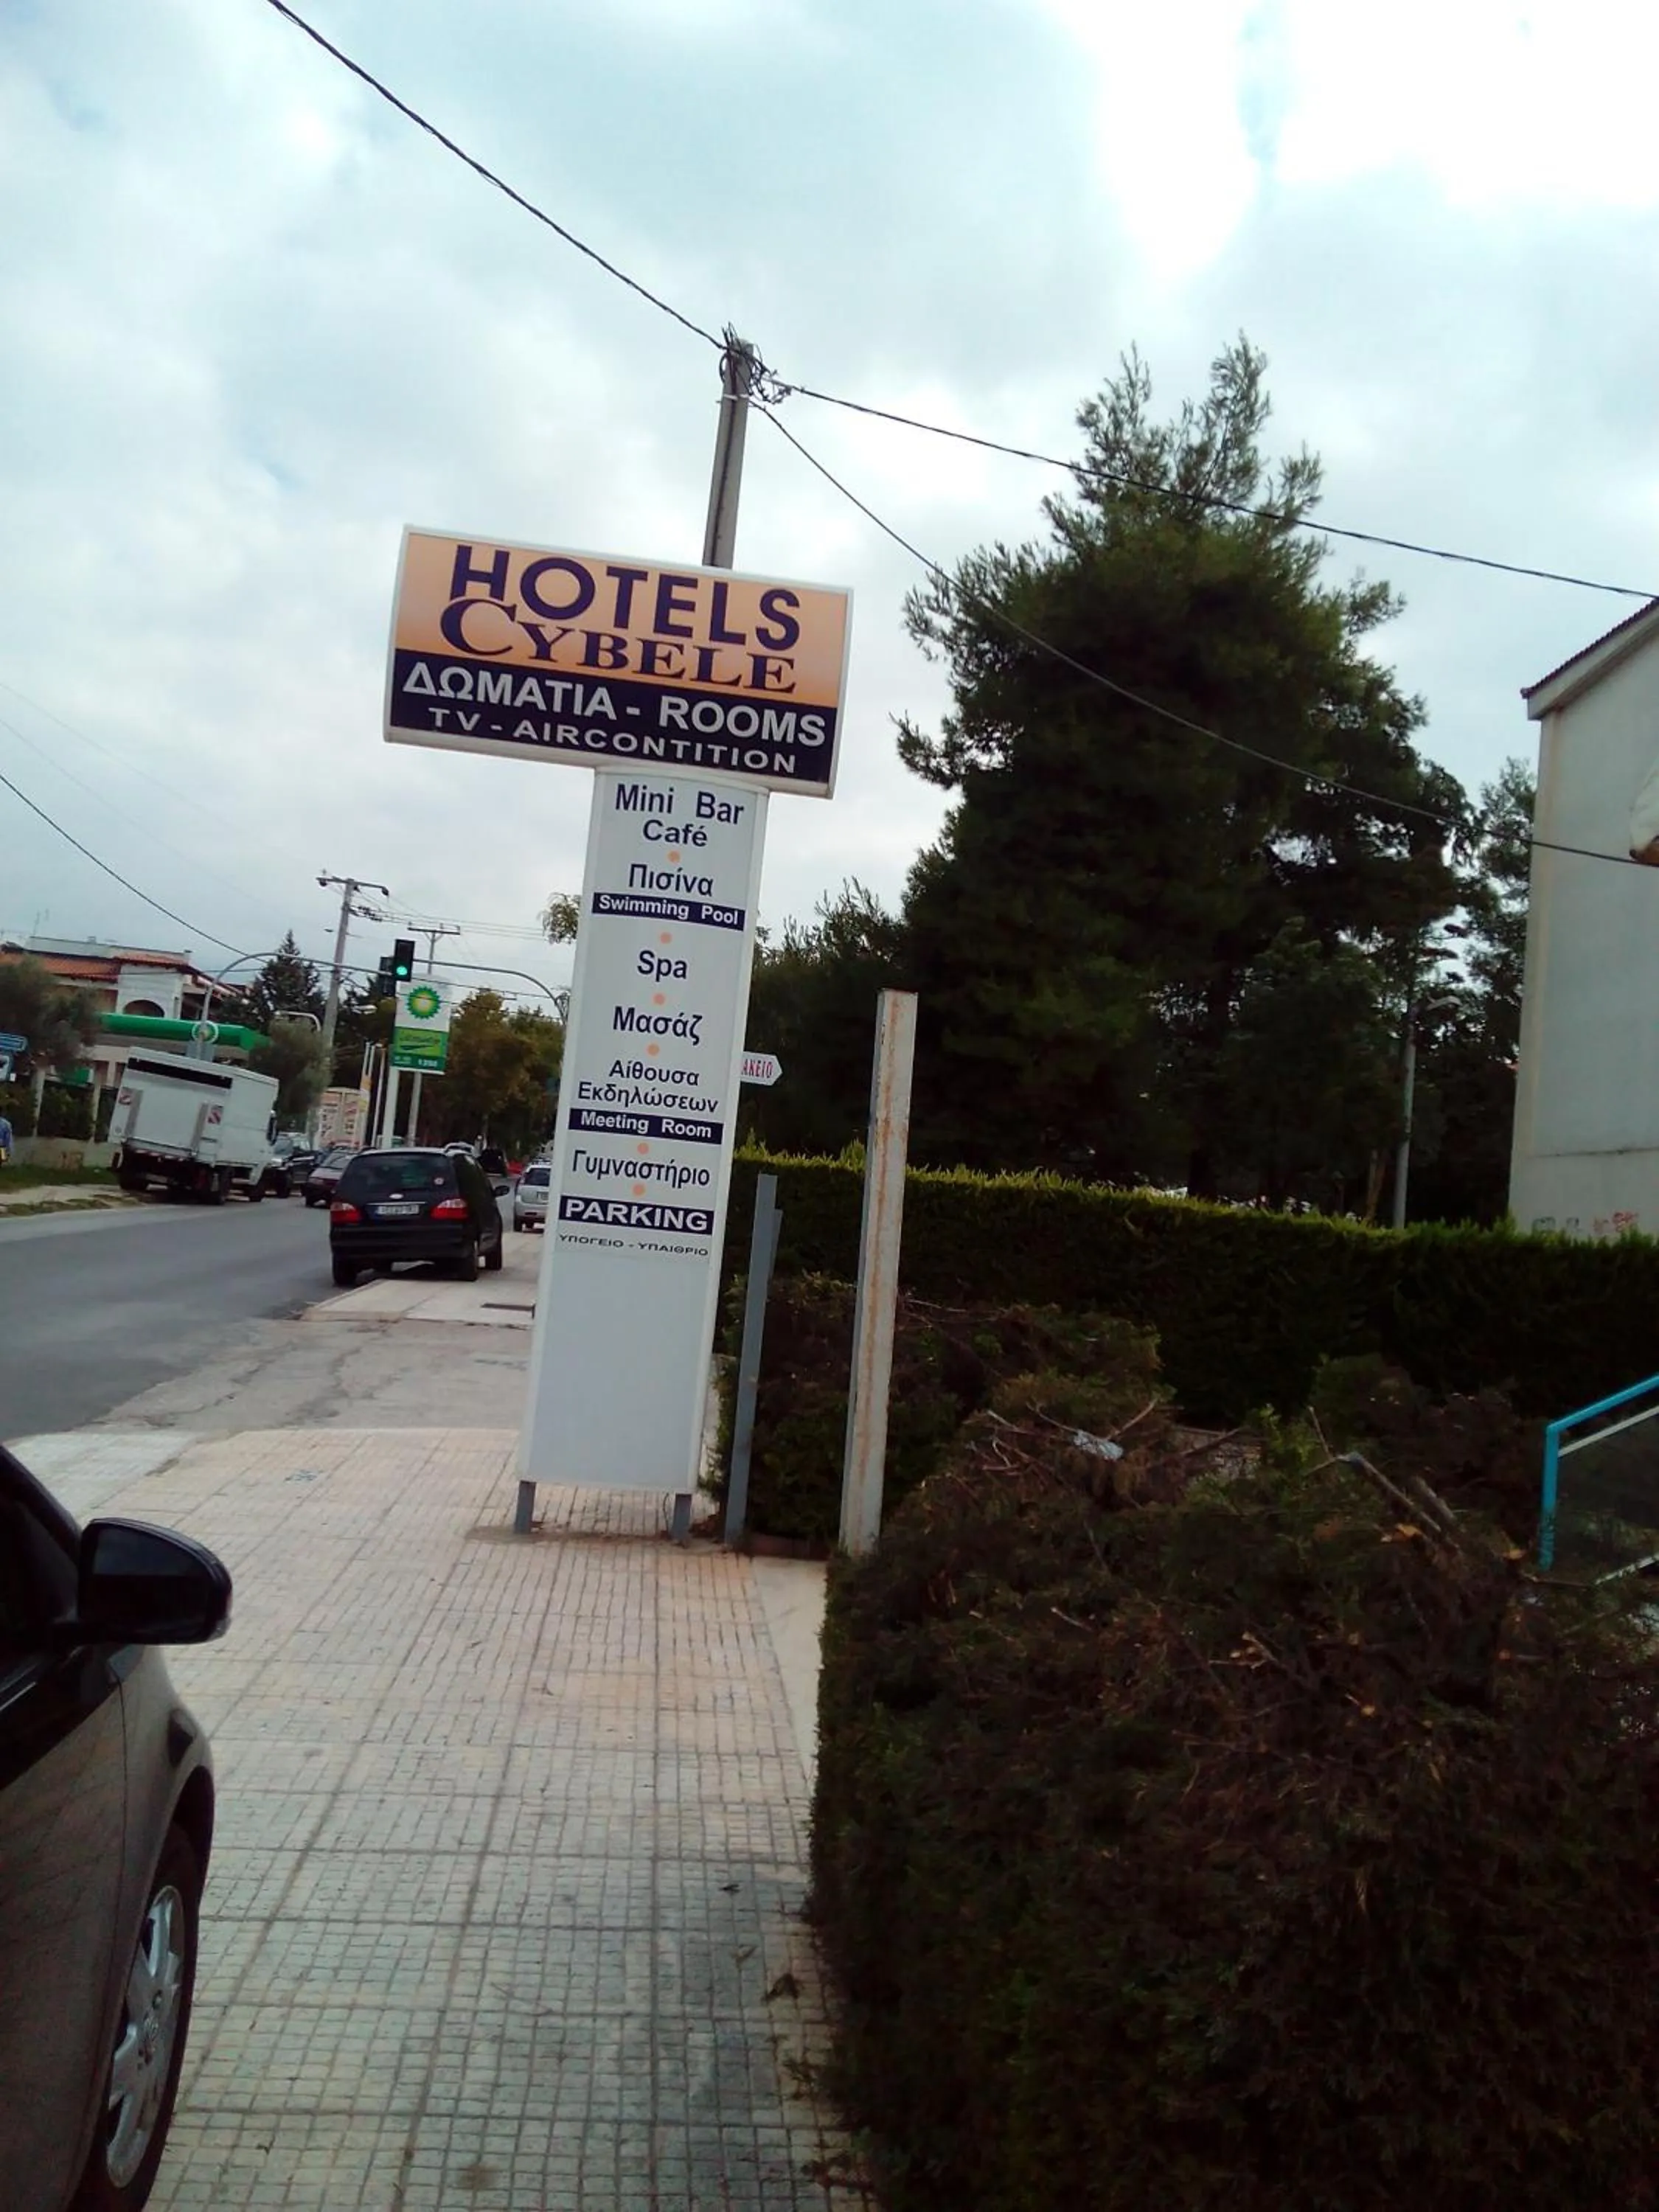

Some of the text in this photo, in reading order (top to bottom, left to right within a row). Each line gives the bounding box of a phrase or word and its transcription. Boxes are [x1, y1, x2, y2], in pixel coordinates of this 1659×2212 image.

[449, 545, 800, 651] HOTELS
[440, 598, 796, 694] CYBELE
[403, 662, 616, 720] ΔΩΜΑΤΙΑ
[660, 701, 826, 747] ROOMS
[428, 708, 481, 731] TV
[513, 720, 796, 773] AIRCONTITION
[615, 784, 745, 824] Mini Bar
[643, 819, 708, 846] Café
[628, 863, 714, 897] Πισίνα
[599, 895, 738, 925] Swimming Pool
[637, 950, 688, 982] Spa
[613, 1006, 703, 1045] Μασάζ
[609, 1060, 700, 1086] Αίθουσα
[578, 1081, 719, 1113] Εκδηλώσεων
[581, 1111, 712, 1138] Meeting Room
[572, 1150, 710, 1188] Γυμναστήριο
[566, 1199, 709, 1231] PARKING
